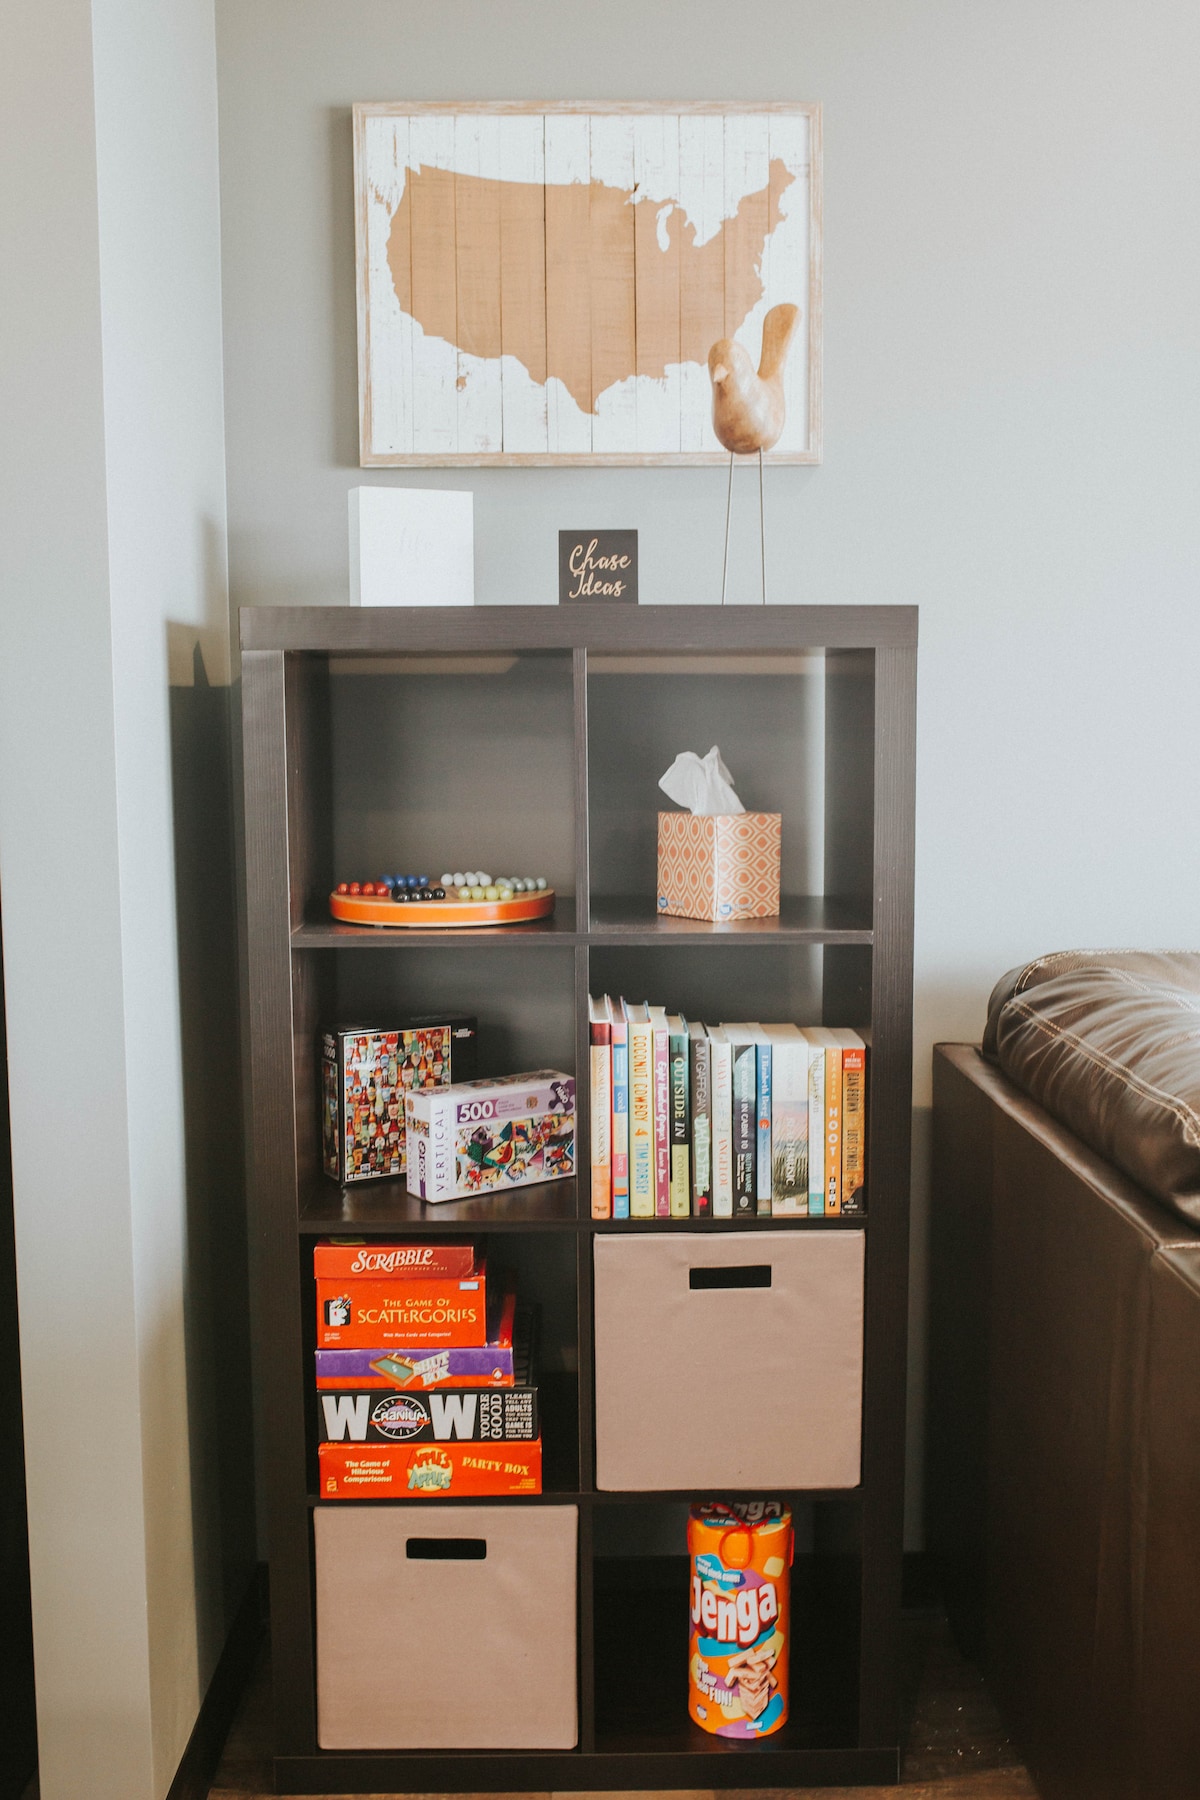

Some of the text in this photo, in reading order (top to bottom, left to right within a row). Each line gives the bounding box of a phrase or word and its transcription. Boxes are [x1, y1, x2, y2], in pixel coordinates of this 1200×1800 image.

[569, 538, 632, 573] Chase
[568, 570, 627, 599] Ideas
[633, 1036, 649, 1122] COCONUT COWBOY
[695, 1043, 707, 1112] JIM GAFFIGAN
[718, 1059, 727, 1088] MAYA
[847, 1072, 859, 1087] DAN
[674, 1057, 685, 1138] OUTSIDE IN
[760, 1055, 769, 1117] Elizabeth Berg
[813, 1076, 822, 1113] bryson
[459, 1100, 494, 1123] 500
[617, 1092, 626, 1112] cook
[741, 1103, 749, 1112] IN
[847, 1088, 859, 1112] BROWN
[741, 1114, 749, 1138] CABIN
[829, 1107, 839, 1157] HOOT
[435, 1109, 445, 1192] VERTICAL
[741, 1140, 749, 1150] 10
[847, 1130, 858, 1170] LOST SYMBOL
[618, 1154, 626, 1172] love
[635, 1143, 649, 1194] TIM DORSEY
[677, 1155, 685, 1193] COOPER
[719, 1139, 728, 1186] ANGELOU
[351, 1249, 434, 1273] SCRABBLE
[383, 1298, 451, 1307] THE GAME OF
[357, 1308, 477, 1324] SCATTERGORIES
[422, 1365, 452, 1387] BOX
[321, 1395, 371, 1441] W
[428, 1394, 477, 1440] W
[480, 1394, 490, 1440] YOU'RE
[490, 1394, 503, 1440] GOOD
[505, 1404, 532, 1412] ADULTS
[351, 1468, 384, 1476] Hilarious
[359, 1460, 378, 1468] Game
[461, 1456, 530, 1476] PARTY BOX
[343, 1475, 393, 1484] Comparisons!
[407, 1470, 451, 1490] APPLES
[700, 1501, 783, 1521] nga
[691, 1575, 778, 1643] Jenga
[709, 1686, 733, 1707] FUN!
